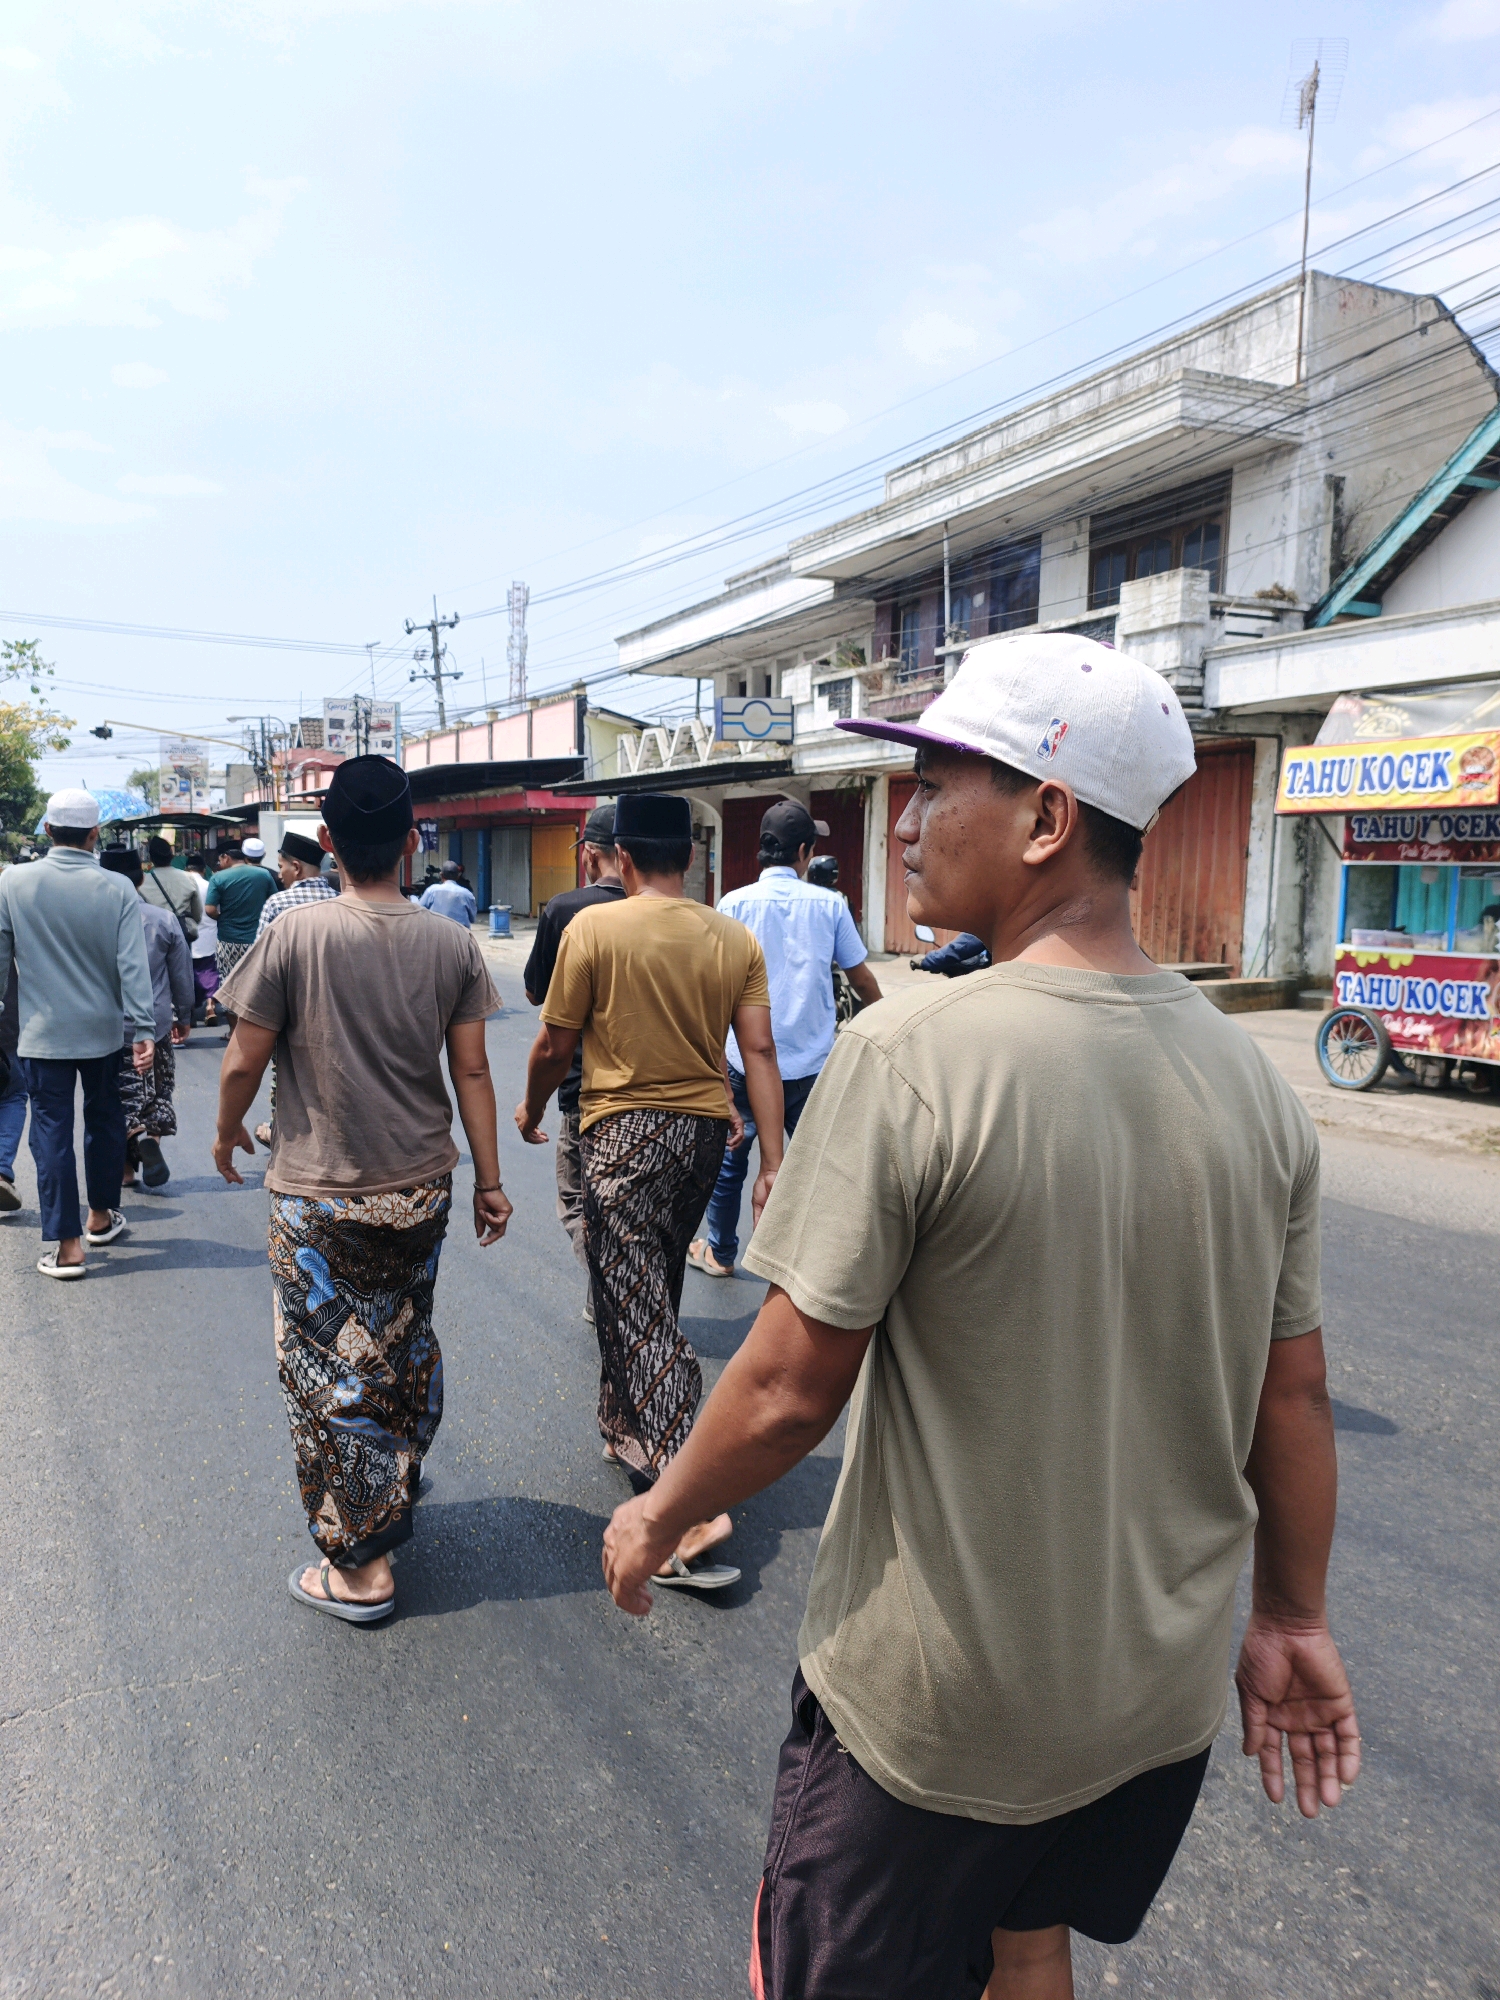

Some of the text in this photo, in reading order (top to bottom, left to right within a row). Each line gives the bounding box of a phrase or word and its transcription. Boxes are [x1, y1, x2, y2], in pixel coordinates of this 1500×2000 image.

[1286, 750, 1451, 796] TAHU KOCEK
[1353, 815, 1416, 839] TAHU
[1338, 973, 1488, 1016] TAHU KOCEK
